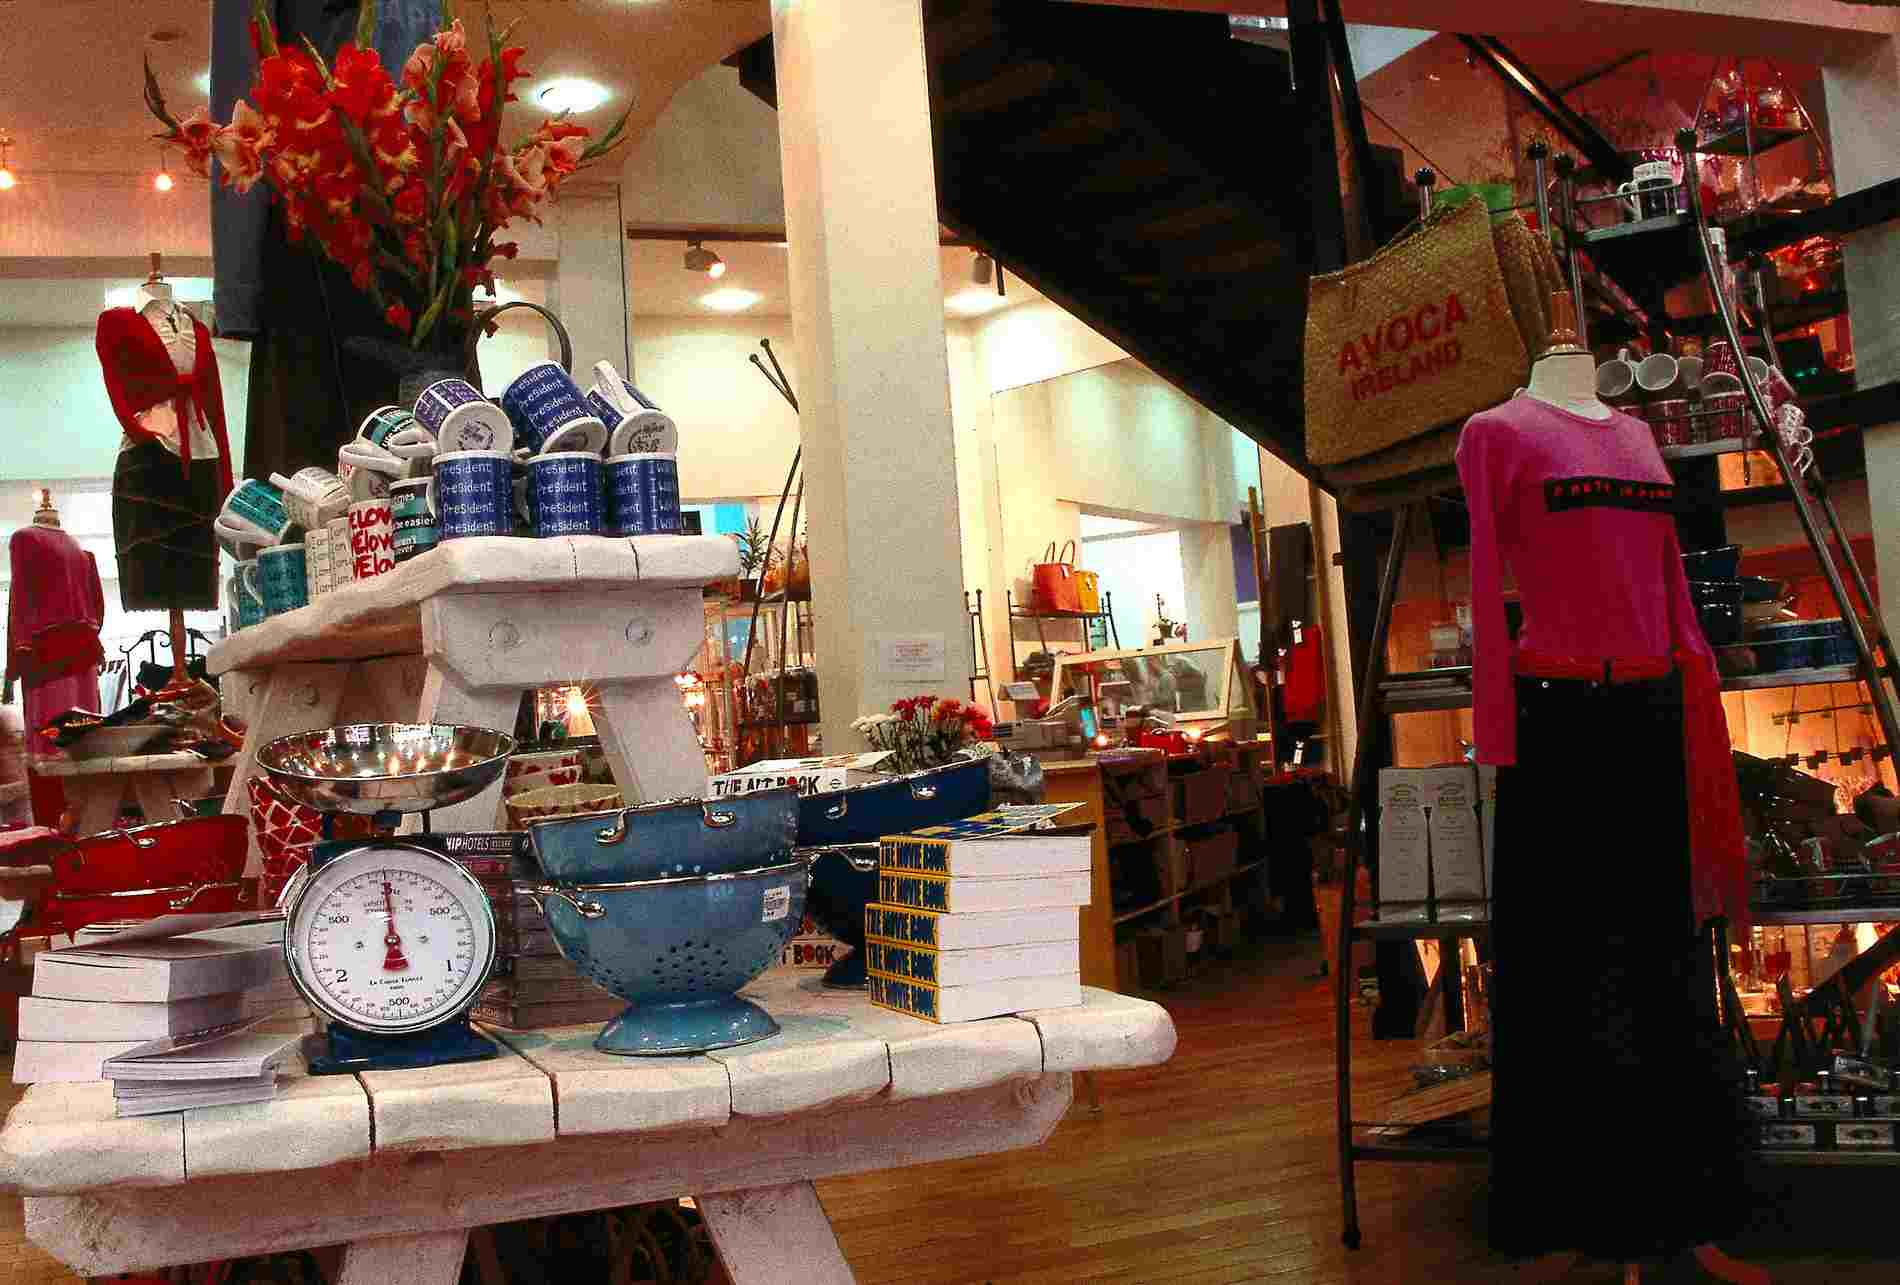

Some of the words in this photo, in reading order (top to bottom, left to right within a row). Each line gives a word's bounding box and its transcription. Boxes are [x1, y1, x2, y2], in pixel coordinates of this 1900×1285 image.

[1337, 293, 1468, 375] AVOCA
[1352, 338, 1459, 400] IRELAND
[335, 968, 348, 983] 2
[388, 996, 410, 1007] 500
